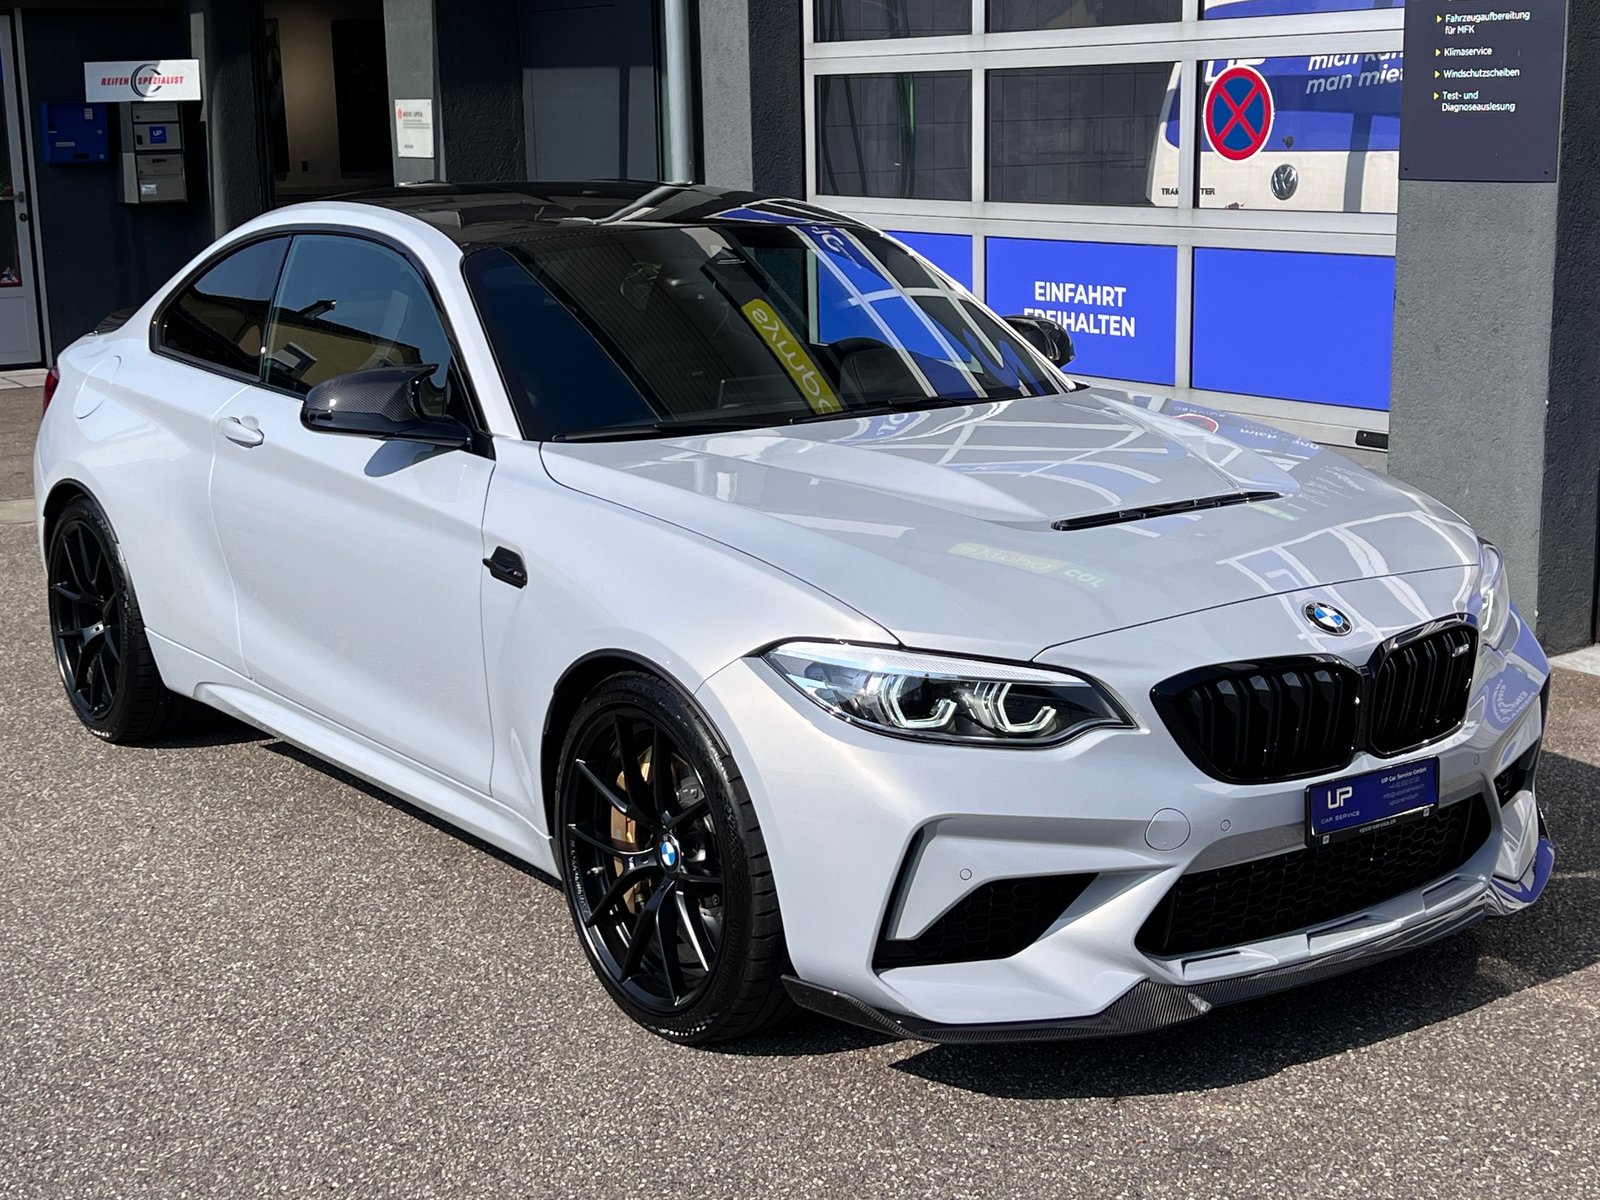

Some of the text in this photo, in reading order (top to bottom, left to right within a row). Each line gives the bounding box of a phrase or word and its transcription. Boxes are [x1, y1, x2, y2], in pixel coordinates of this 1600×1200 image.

[1445, 11, 1531, 23] Fahrzeugaufbereitung
[1445, 25, 1475, 35] für MFK
[1444, 46, 1493, 56] Klimaservice
[1443, 68, 1520, 78] Windschutzscheiben
[101, 76, 184, 86] REIFEN SPEZIALIST
[1306, 63, 1404, 94] man mie
[1442, 91, 1479, 100] Test- und
[1442, 102, 1516, 112] Diagnoseauslesung
[1034, 281, 1127, 307] EINFAHRT
[1327, 786, 1353, 809] UP
[1321, 810, 1360, 825] CAR SERVICE
